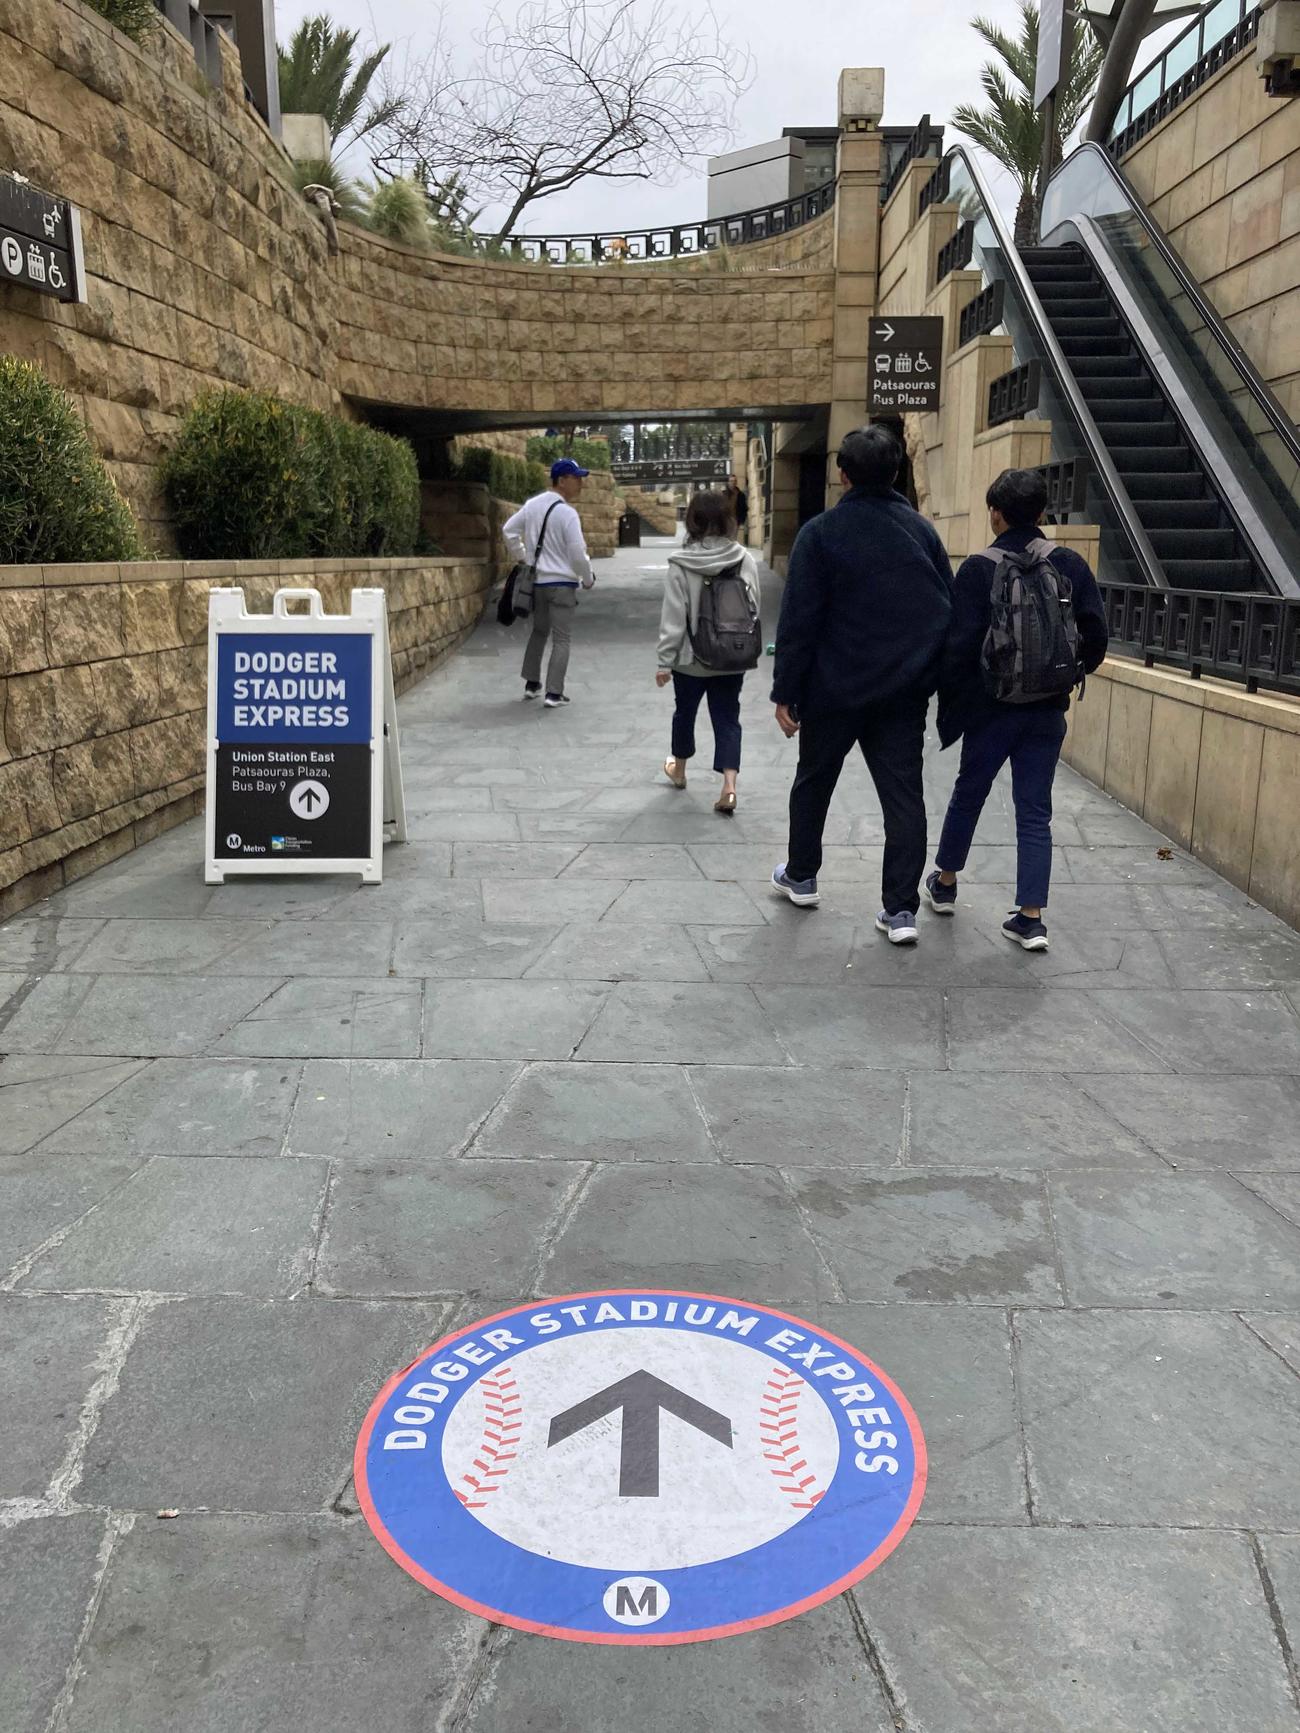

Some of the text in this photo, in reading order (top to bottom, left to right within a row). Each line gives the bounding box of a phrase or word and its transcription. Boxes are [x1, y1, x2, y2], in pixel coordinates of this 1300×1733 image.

[873, 379, 936, 391] Patsaouras
[873, 393, 927, 405] Bus Plaza
[234, 652, 337, 674] DODGER
[233, 679, 346, 700] STADIUM
[234, 705, 350, 727] EXPRESS
[232, 751, 335, 762] Union Station East
[232, 766, 331, 778] Patsaouras Plaza,
[232, 780, 287, 794] Bus Bay 9
[228, 836, 240, 847] M
[243, 845, 266, 853] Metro
[384, 1300, 900, 1477] DODGER STADIUM EXPRESS
[615, 1585, 658, 1617] M
